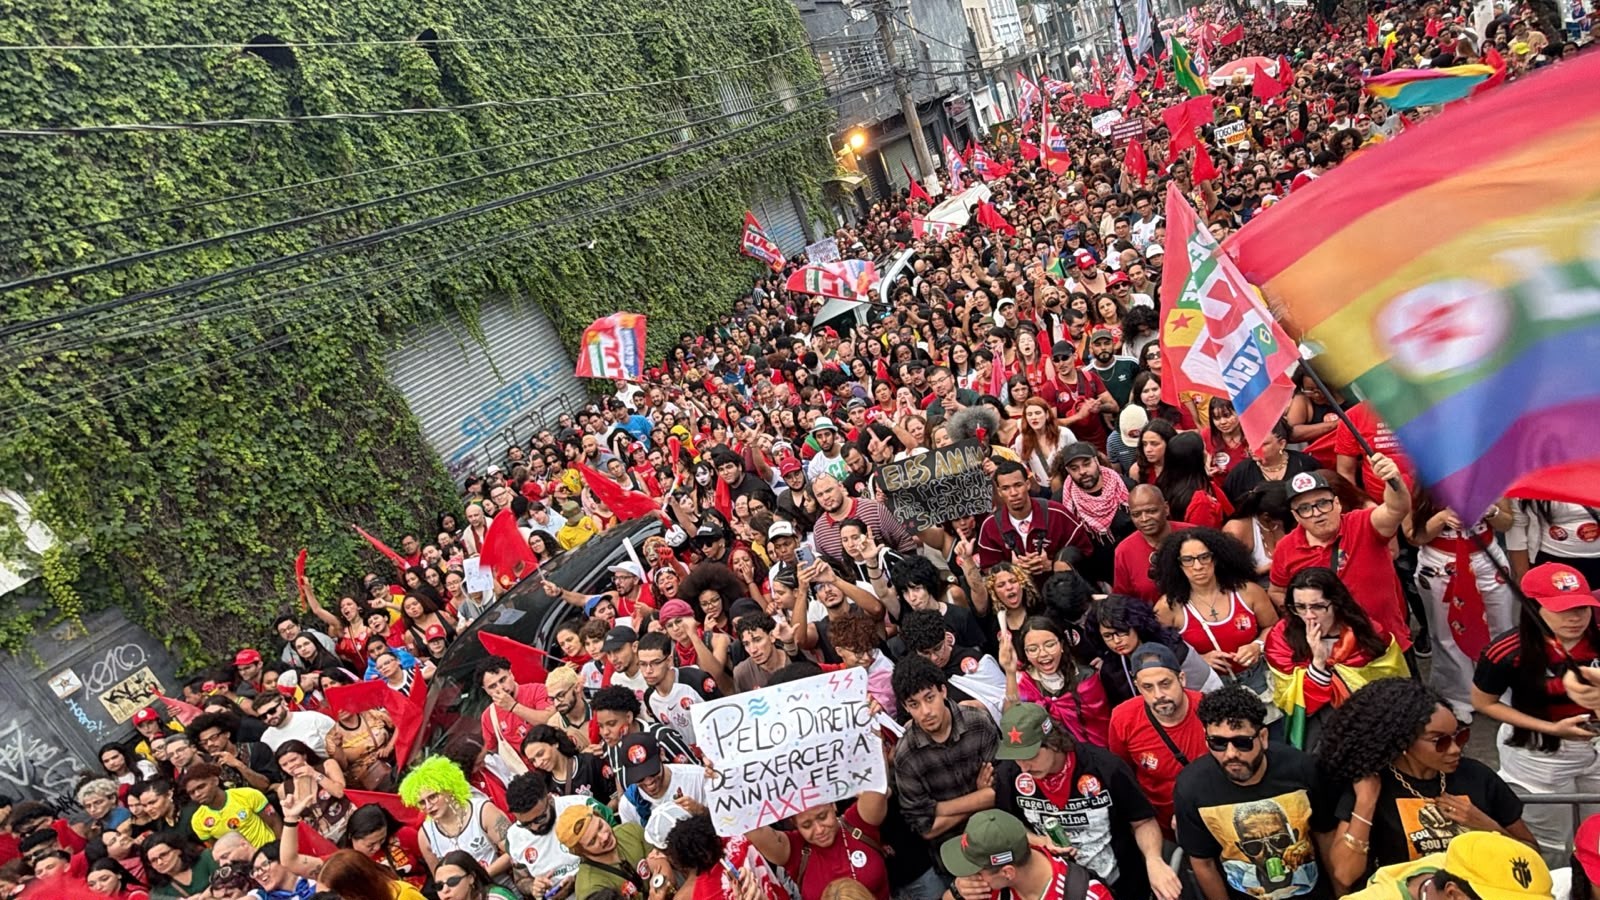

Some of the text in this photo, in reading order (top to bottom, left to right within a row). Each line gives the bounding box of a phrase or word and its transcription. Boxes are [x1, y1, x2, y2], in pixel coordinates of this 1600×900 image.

[882, 454, 931, 492] ELES
[700, 701, 873, 759] PELO DIREITO
[711, 734, 871, 791] DE EXERCER A
[715, 760, 839, 813] MINHA FÉ
[756, 781, 821, 828] AXÉ
[1019, 799, 1042, 810] rage
[1046, 800, 1088, 812] agnst
[1410, 831, 1430, 842] SOU
[1420, 841, 1441, 851] SOU
